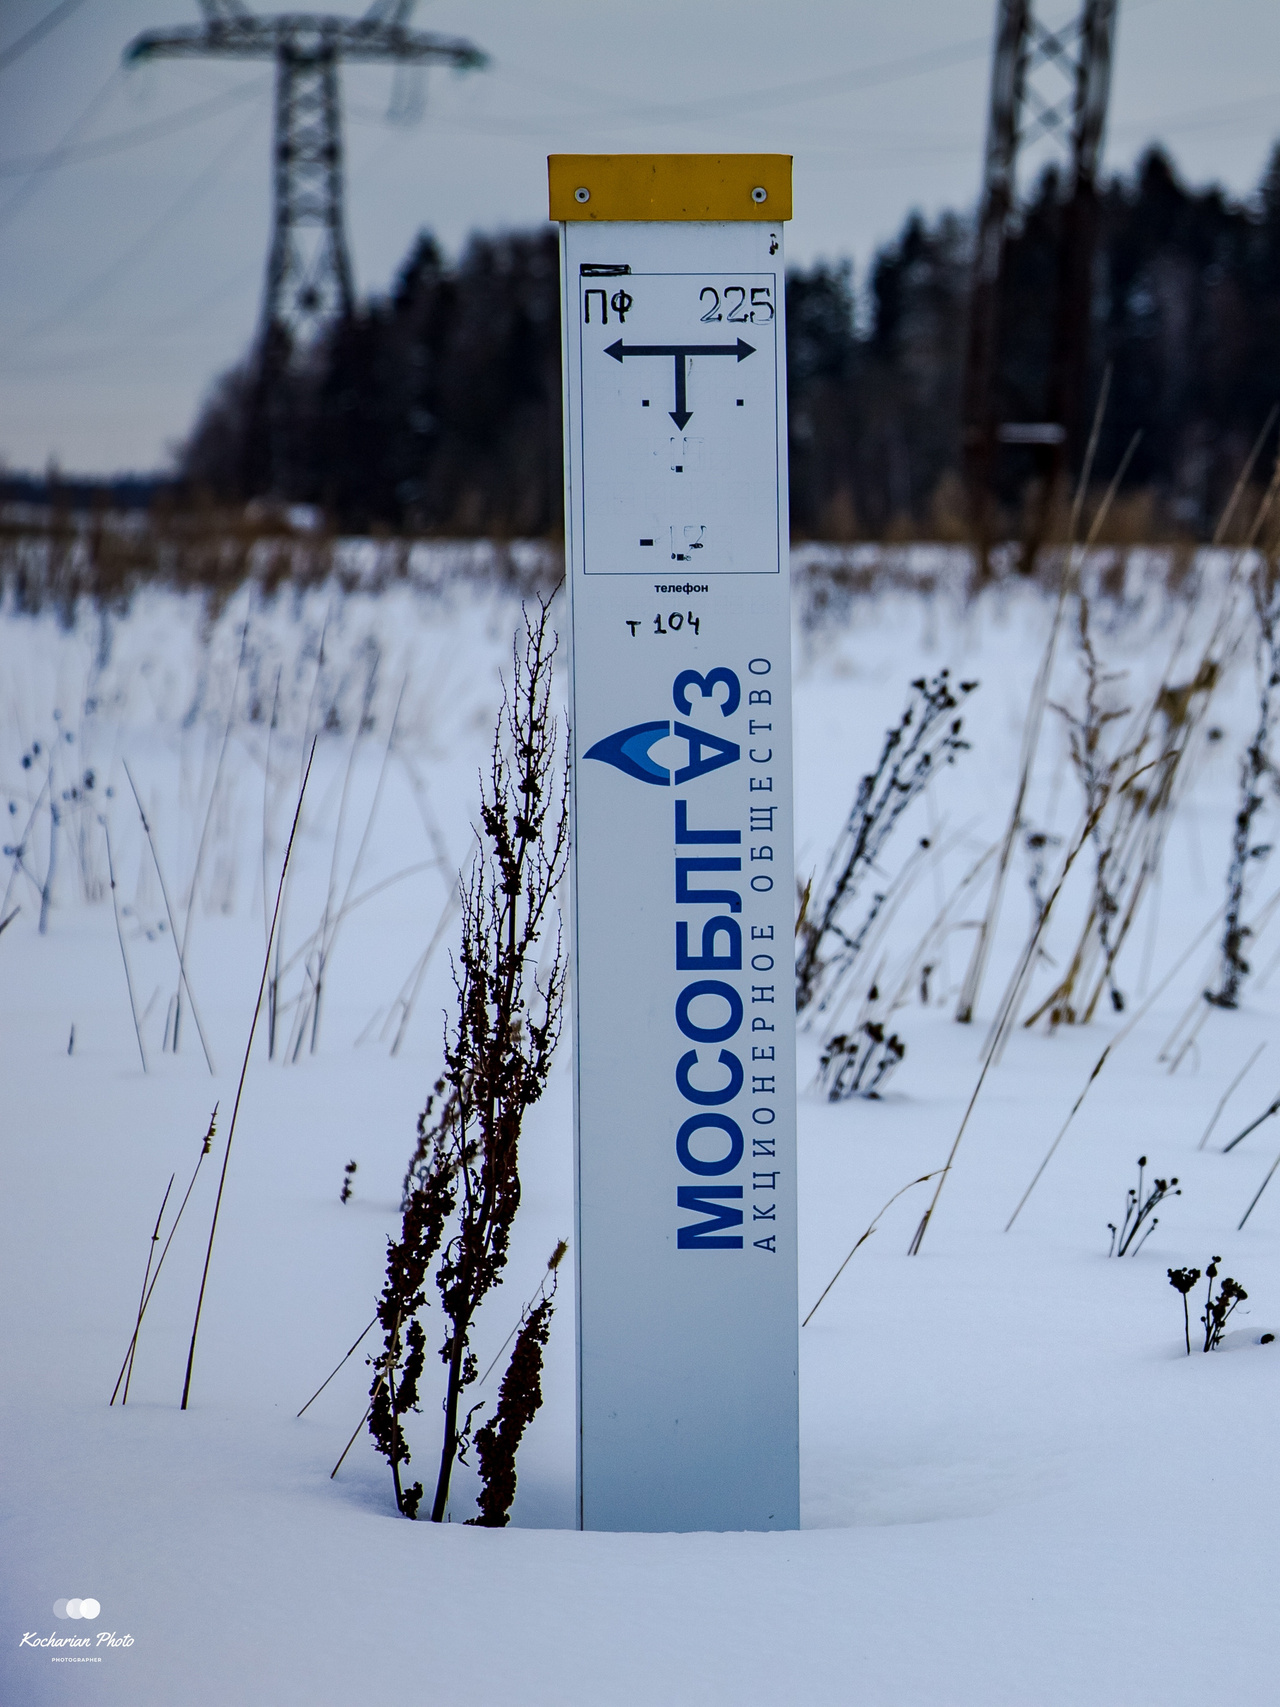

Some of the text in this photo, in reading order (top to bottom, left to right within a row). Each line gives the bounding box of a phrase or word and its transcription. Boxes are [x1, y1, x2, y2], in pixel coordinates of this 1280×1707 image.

[584, 289, 633, 324] ПФ
[699, 286, 774, 325] 225
[654, 583, 709, 595] телефон
[654, 611, 700, 635] 104
[673, 667, 744, 1249] МОСОБЛГАЗ
[748, 658, 780, 1253] АКЦИОНЕРНОЕ ОБЩЕСТВО
